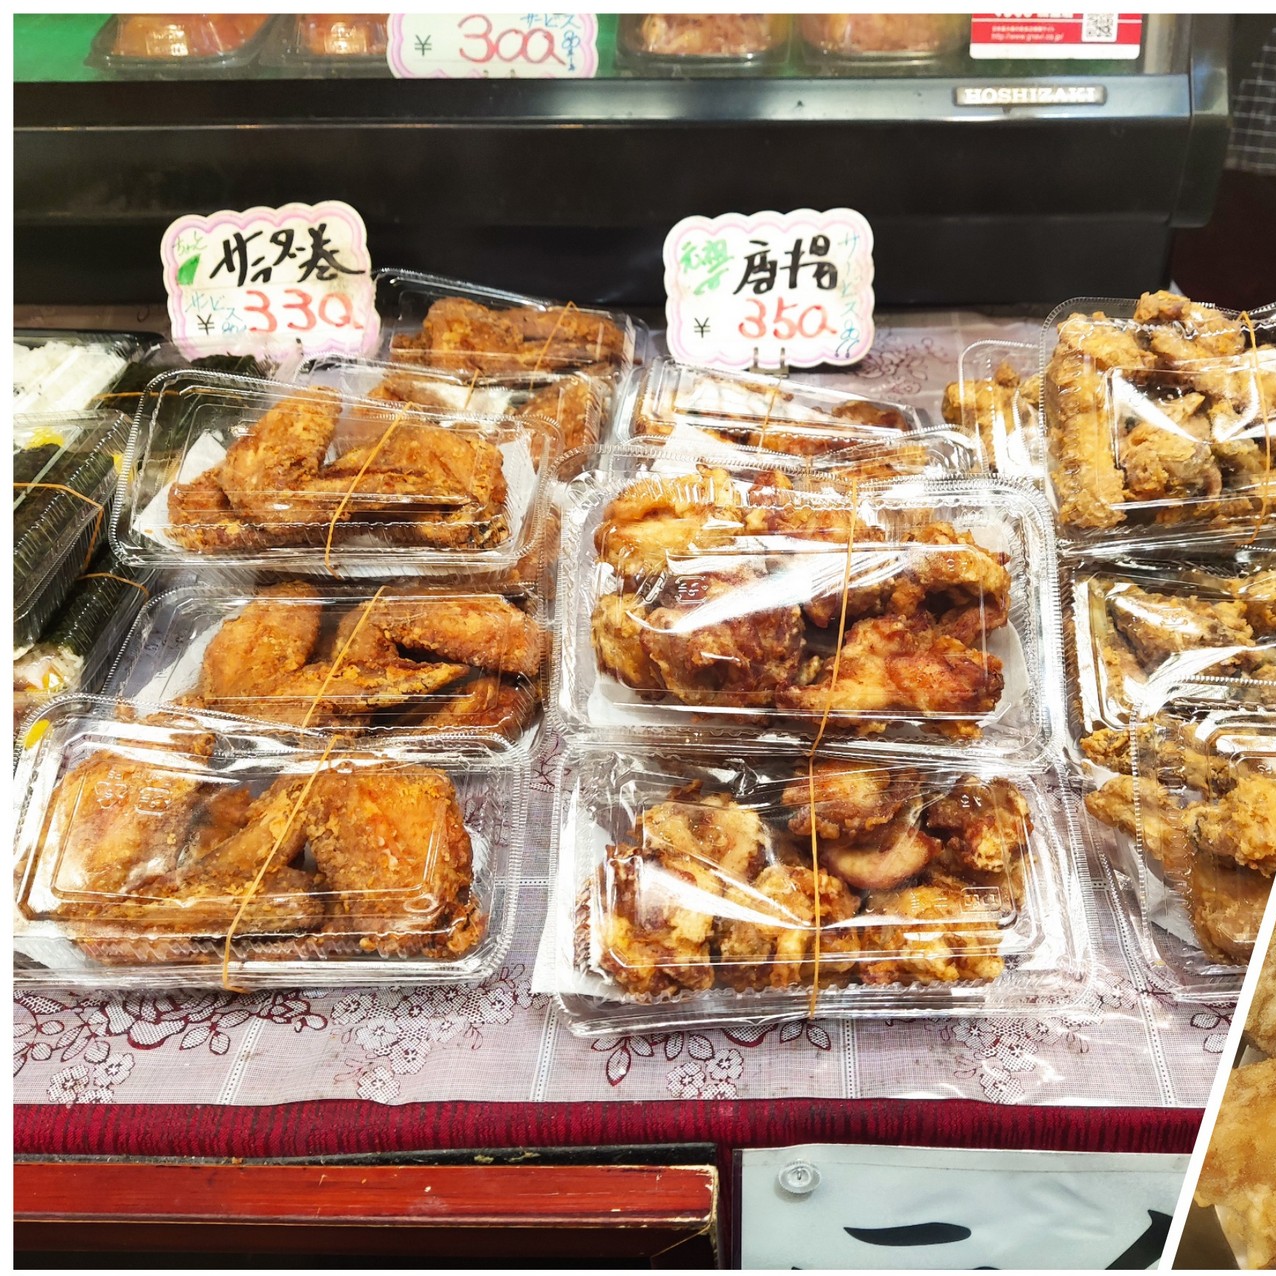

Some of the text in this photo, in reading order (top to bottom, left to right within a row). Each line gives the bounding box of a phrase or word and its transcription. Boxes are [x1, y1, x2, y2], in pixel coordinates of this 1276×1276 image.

[414, 14, 566, 65] ¥ 300
[964, 86, 1096, 105] HOSHIZAKI
[732, 234, 838, 295] 唐揚
[197, 288, 364, 335] ¥ 330
[694, 296, 838, 340] ¥ 350
